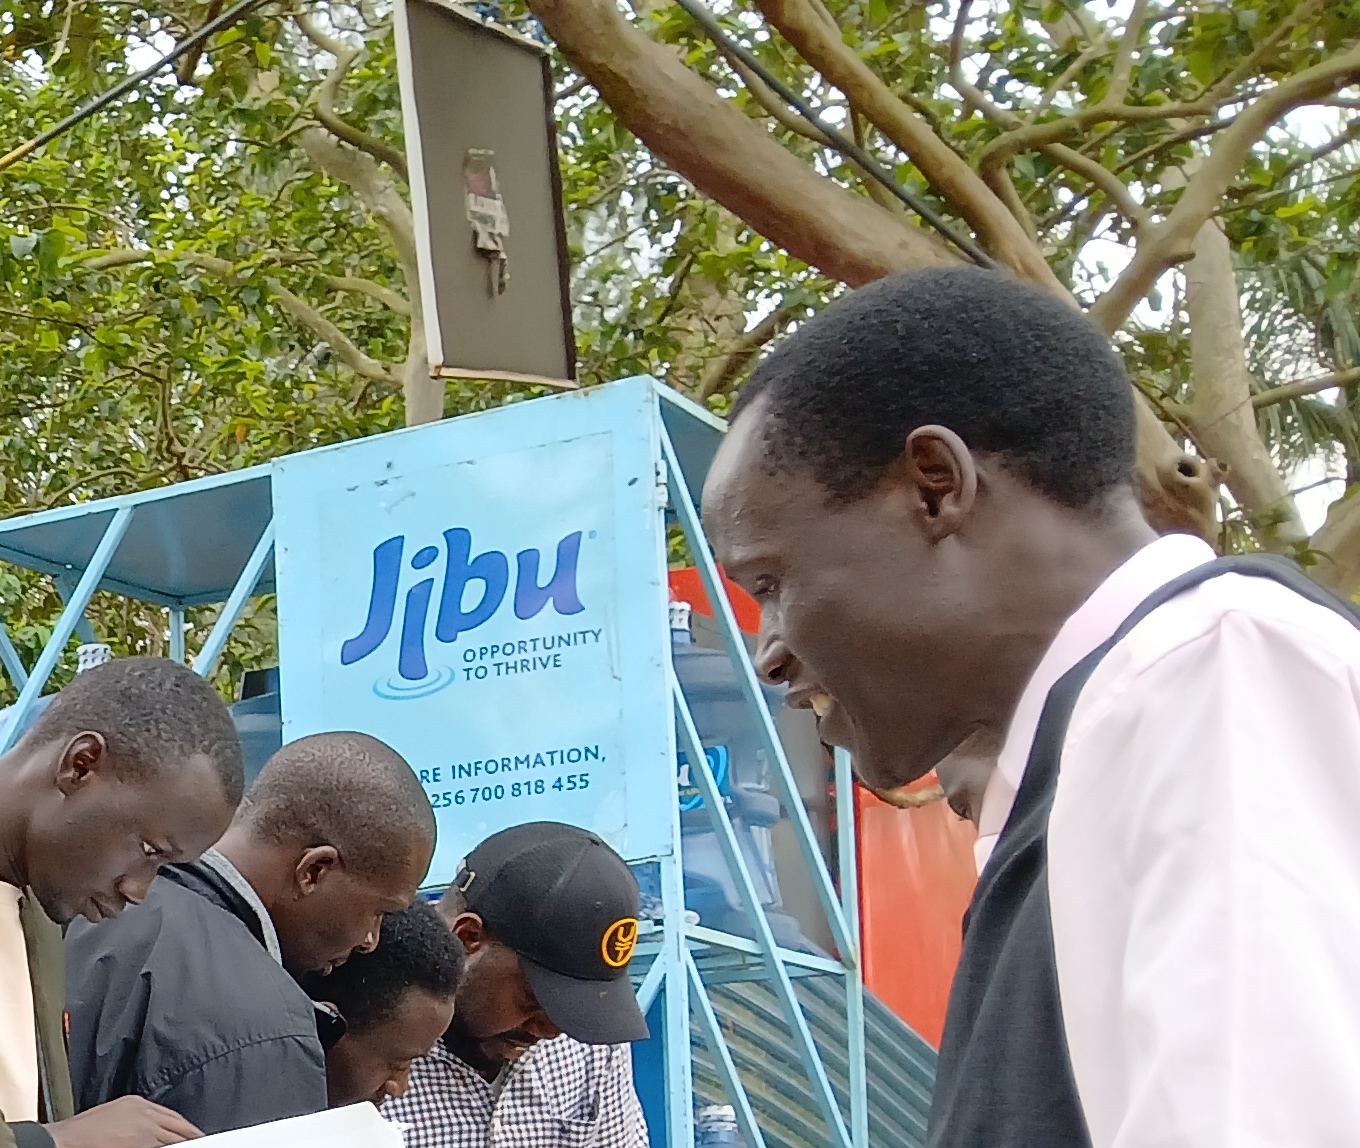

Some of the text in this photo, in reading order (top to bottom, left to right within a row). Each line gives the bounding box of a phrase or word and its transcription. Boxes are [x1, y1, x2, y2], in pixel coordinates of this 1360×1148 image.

[341, 527, 585, 681] Jibu
[463, 629, 602, 663] OPPORTUNITY
[463, 653, 562, 681] TO THRIVE
[452, 745, 606, 780] INFORMATION,
[431, 773, 589, 808] 256 700 818 455
